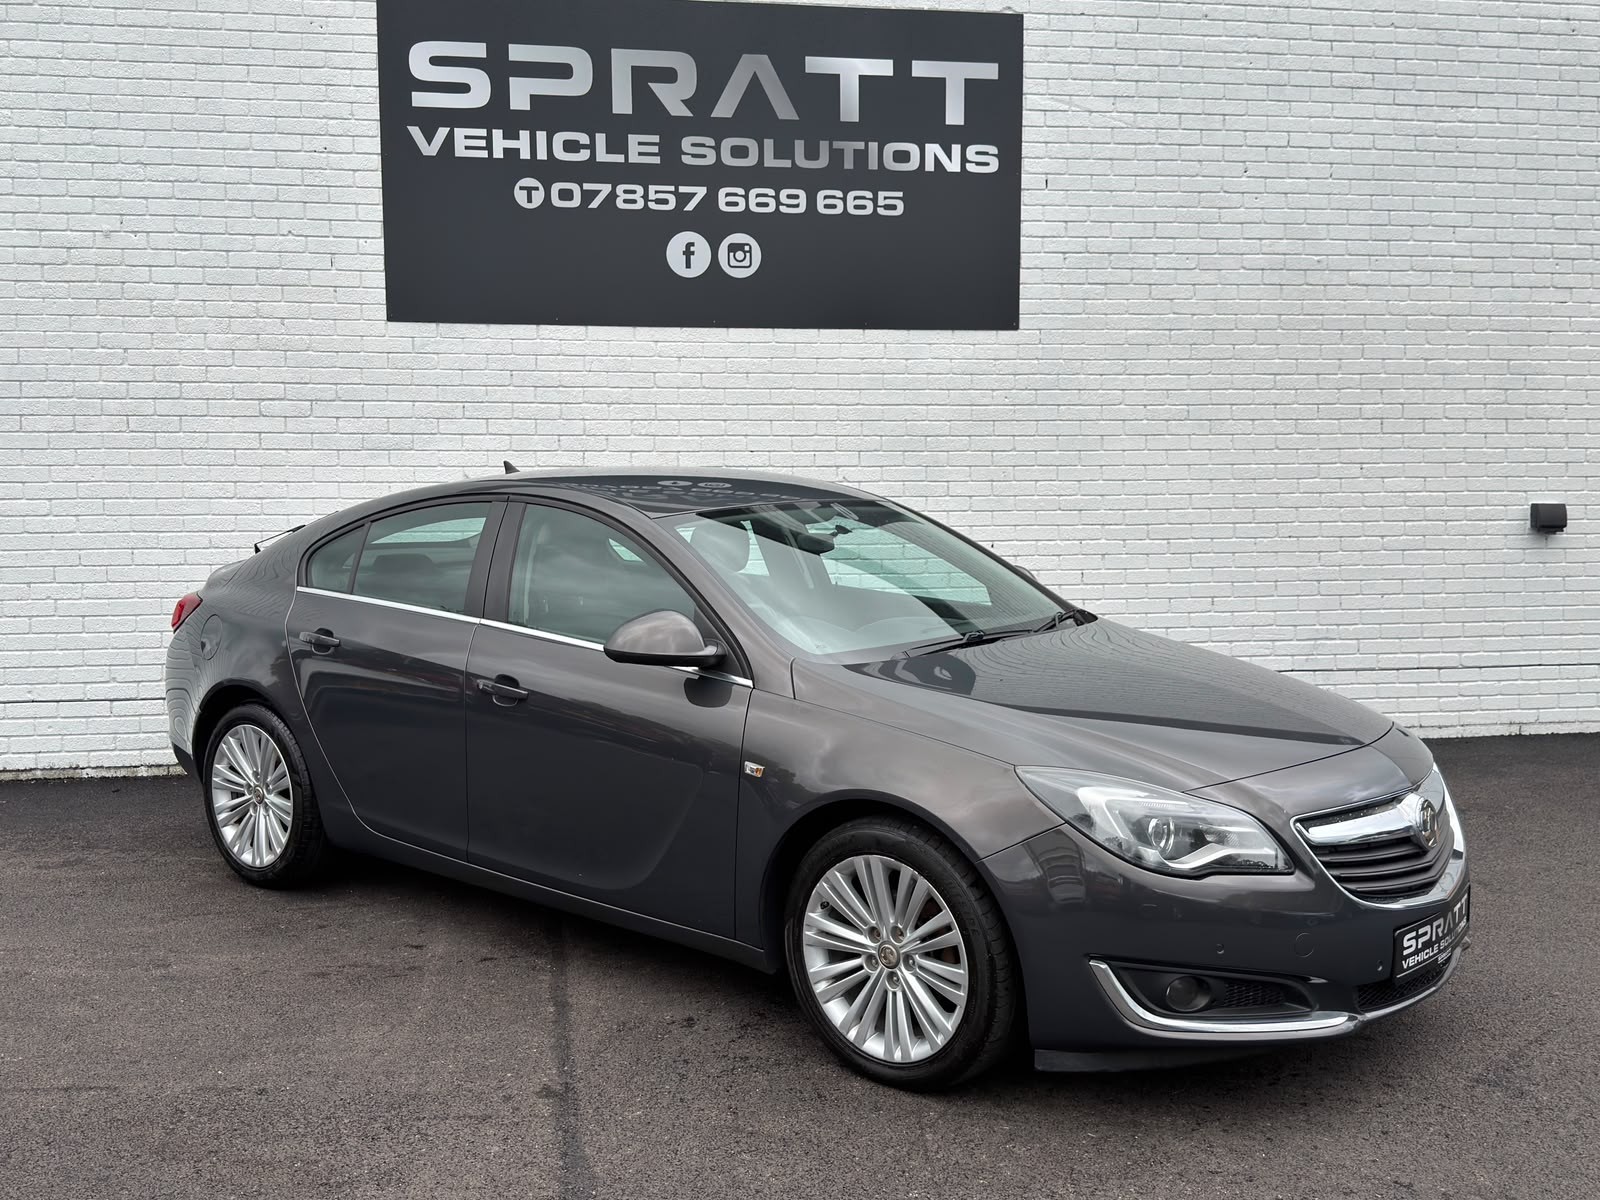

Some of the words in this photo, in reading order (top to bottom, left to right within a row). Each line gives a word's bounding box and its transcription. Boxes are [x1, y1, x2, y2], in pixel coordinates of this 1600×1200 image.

[408, 40, 999, 126] SPRATT
[406, 125, 661, 165] VEHICLE
[680, 135, 1000, 174] SOLUTIONS
[550, 181, 708, 212] 07857
[717, 186, 807, 214] 669
[816, 189, 905, 217] 665
[1403, 893, 1468, 956] SPRATT
[1402, 943, 1439, 969] VEHICLE
